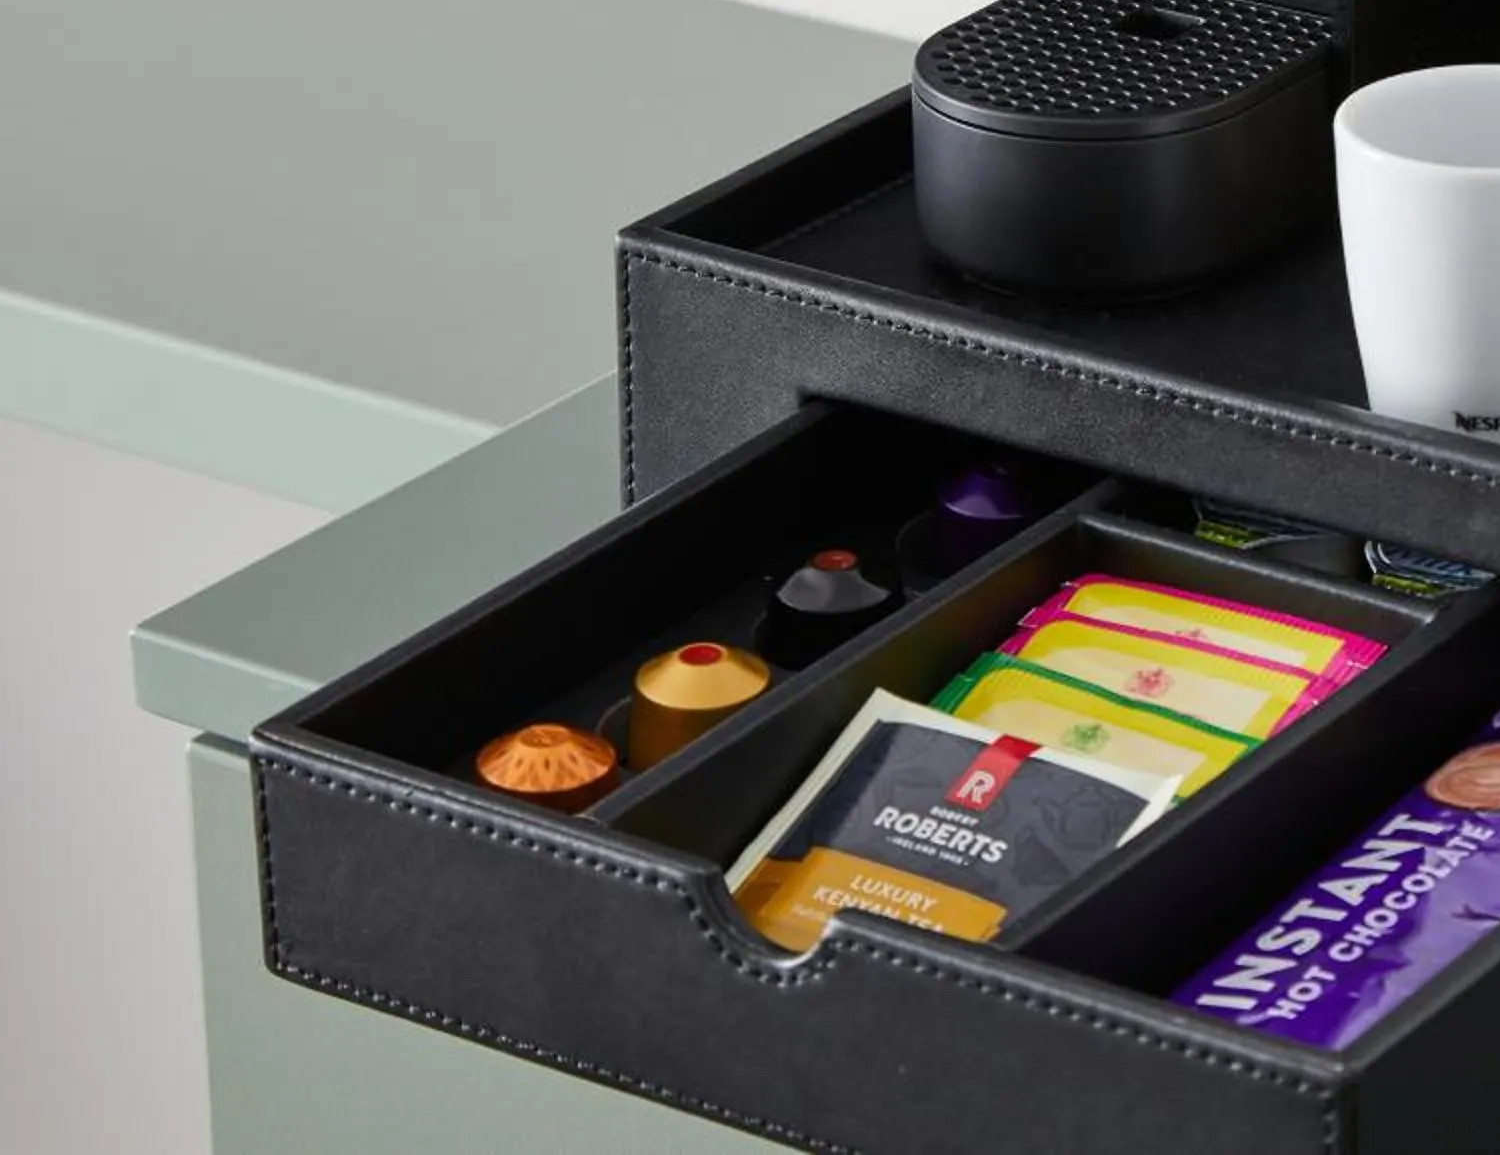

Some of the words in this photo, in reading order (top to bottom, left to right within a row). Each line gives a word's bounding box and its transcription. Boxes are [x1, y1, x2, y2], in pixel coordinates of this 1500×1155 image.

[957, 770, 996, 806] R
[872, 805, 1010, 863] ROBERTS
[850, 873, 939, 913] LUXURY
[1195, 813, 1446, 1010] INSTANT
[1265, 965, 1336, 1020] HOT
[1328, 819, 1495, 962] CHOCOLATE
